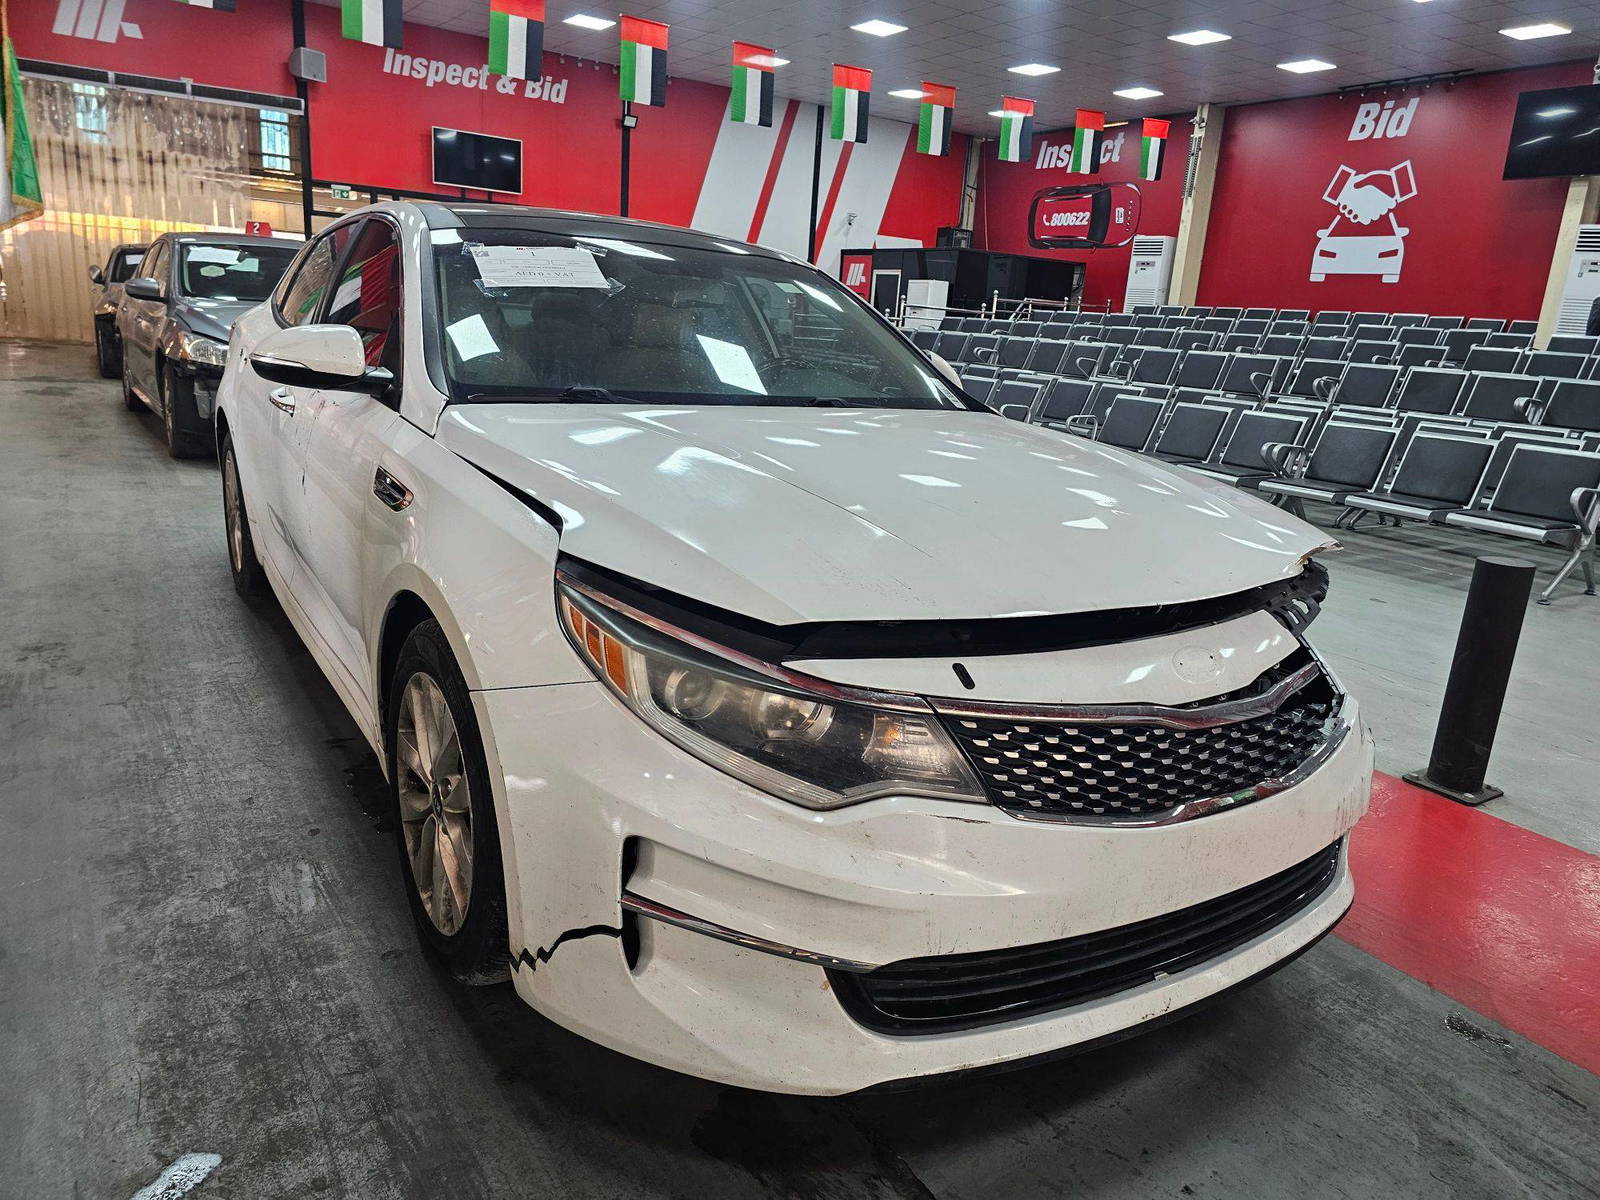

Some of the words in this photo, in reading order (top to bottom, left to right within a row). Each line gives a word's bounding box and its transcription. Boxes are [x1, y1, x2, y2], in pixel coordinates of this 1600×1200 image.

[383, 48, 489, 90] Inspect
[496, 74, 517, 95] &
[524, 75, 568, 104] Bid
[1347, 97, 1420, 141] Bid
[1035, 132, 1125, 173] Insct
[253, 222, 260, 233] 2
[1051, 212, 1090, 226] 800622
